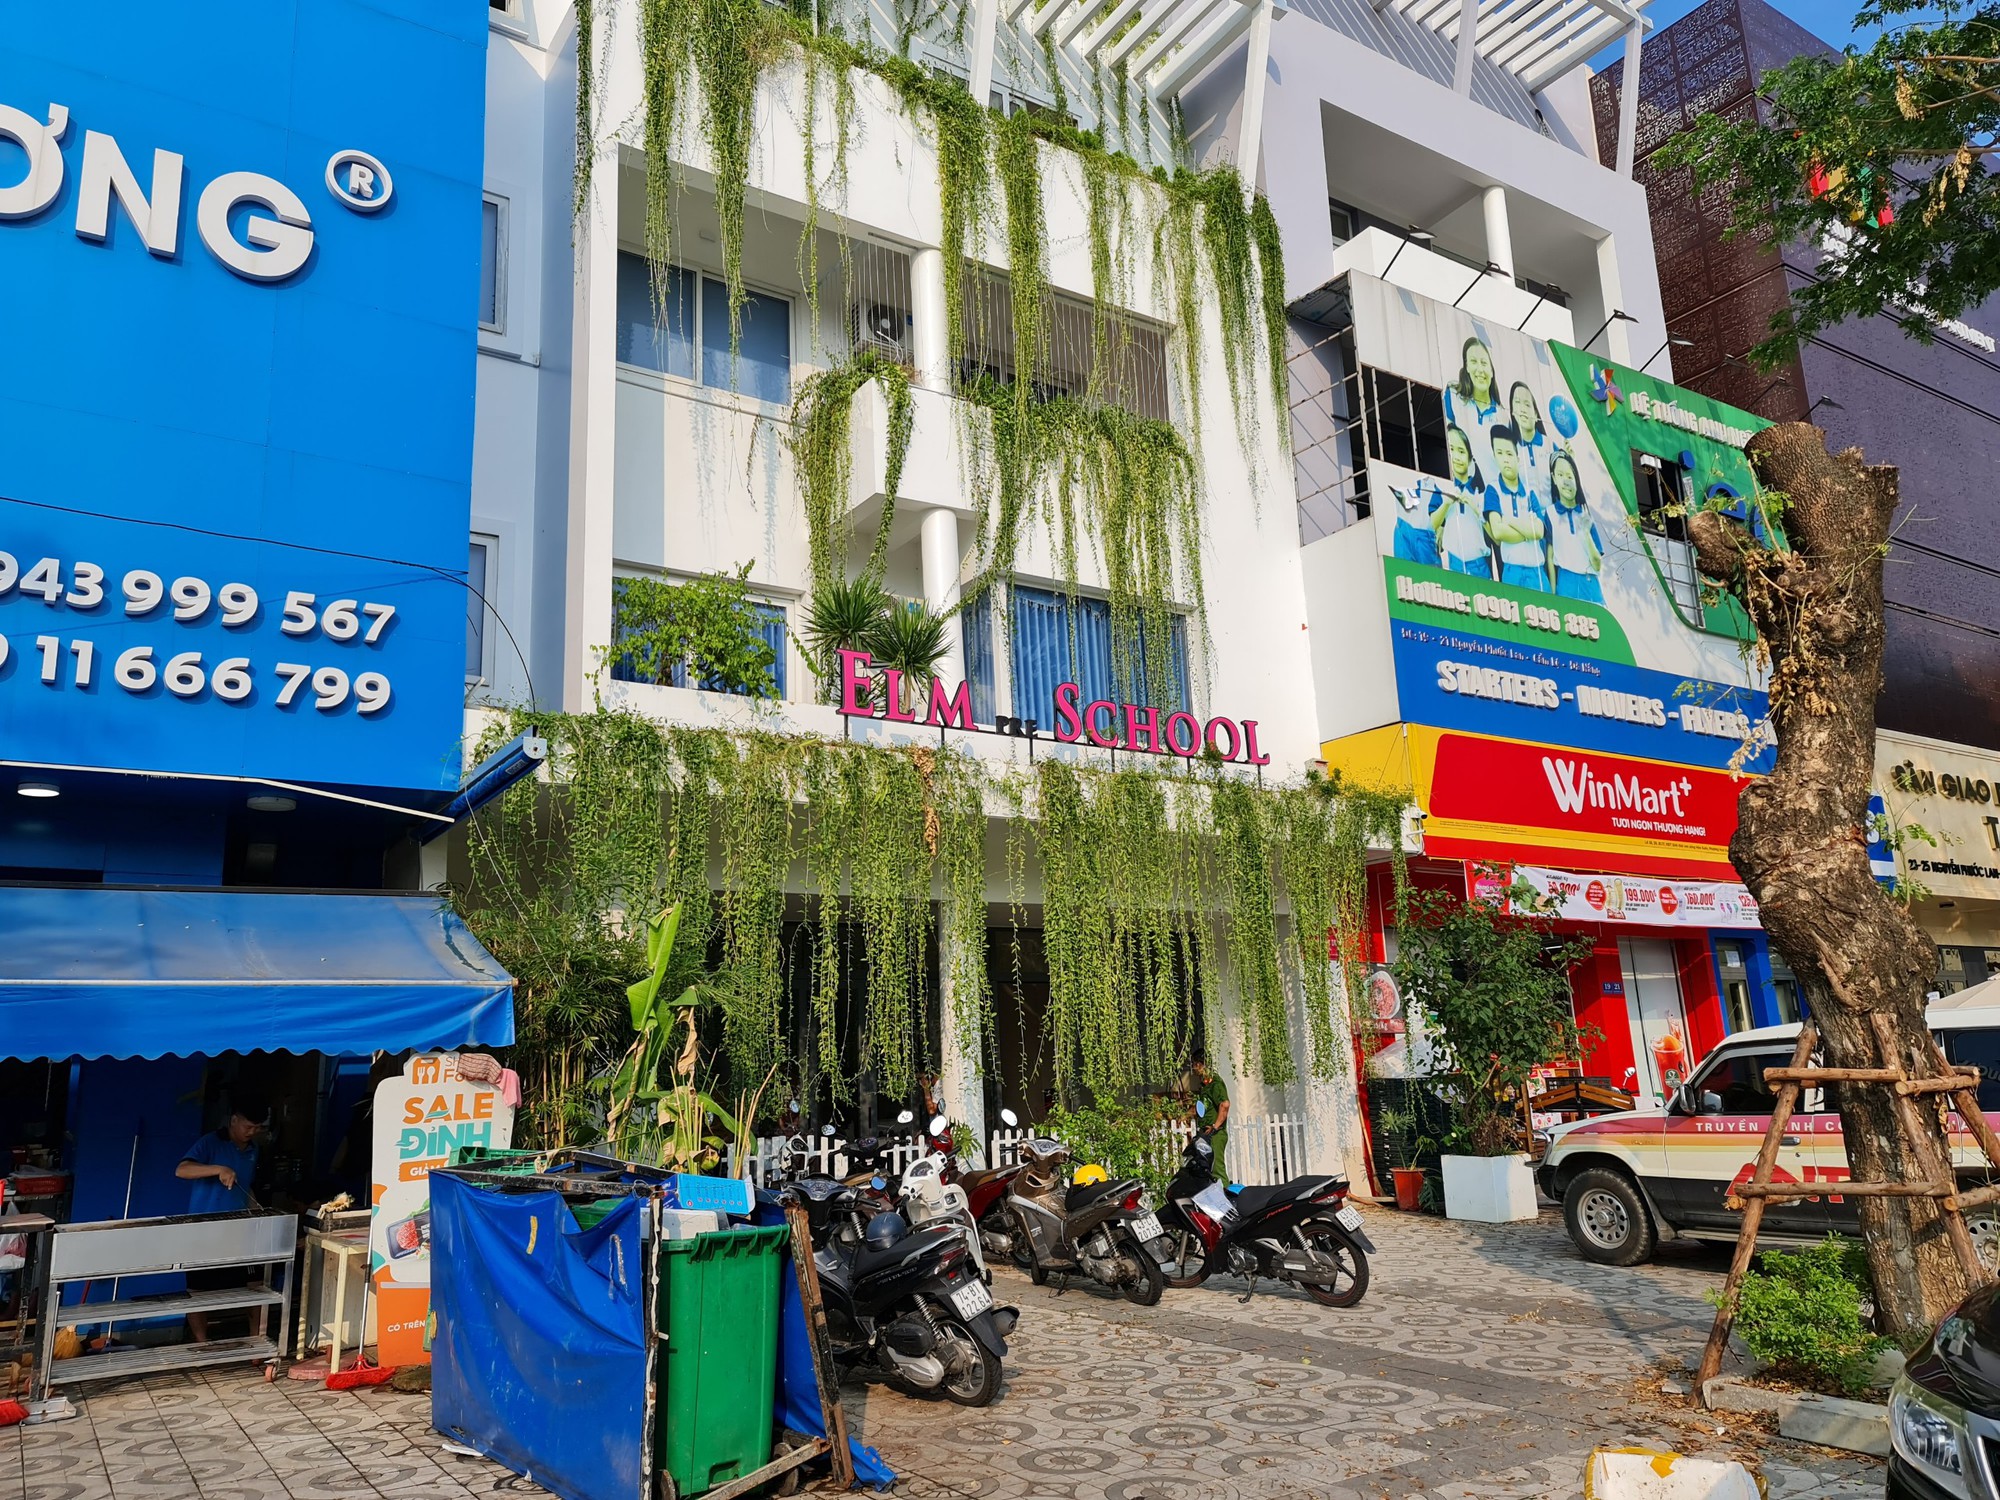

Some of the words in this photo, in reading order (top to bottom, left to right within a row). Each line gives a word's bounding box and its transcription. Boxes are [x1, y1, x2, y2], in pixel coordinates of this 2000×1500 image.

[1630, 391, 1651, 421] HỆ
[123, 570, 259, 626] 999
[281, 591, 396, 643] 567
[1396, 575, 1471, 614] Hotline:
[1473, 593, 1520, 625] 0901
[1524, 604, 1561, 632] 996
[114, 646, 252, 702] 666
[274, 662, 391, 714] 799
[836, 648, 979, 732] ELM
[995, 715, 1038, 738] PRE
[1055, 682, 1270, 765] SCHOOL
[1436, 660, 1559, 709] STARTERS
[1576, 684, 1667, 727] MOVERS
[1680, 704, 1751, 741] FLYERS
[1937, 773, 1991, 804] GIAO
[1631, 819, 1653, 831] NGON
[402, 1093, 494, 1125] SALE
[1696, 1118, 1759, 1132] TRUYỀN
[387, 1321, 401, 1332] CÓ
[403, 1319, 425, 1330] TRÊN
